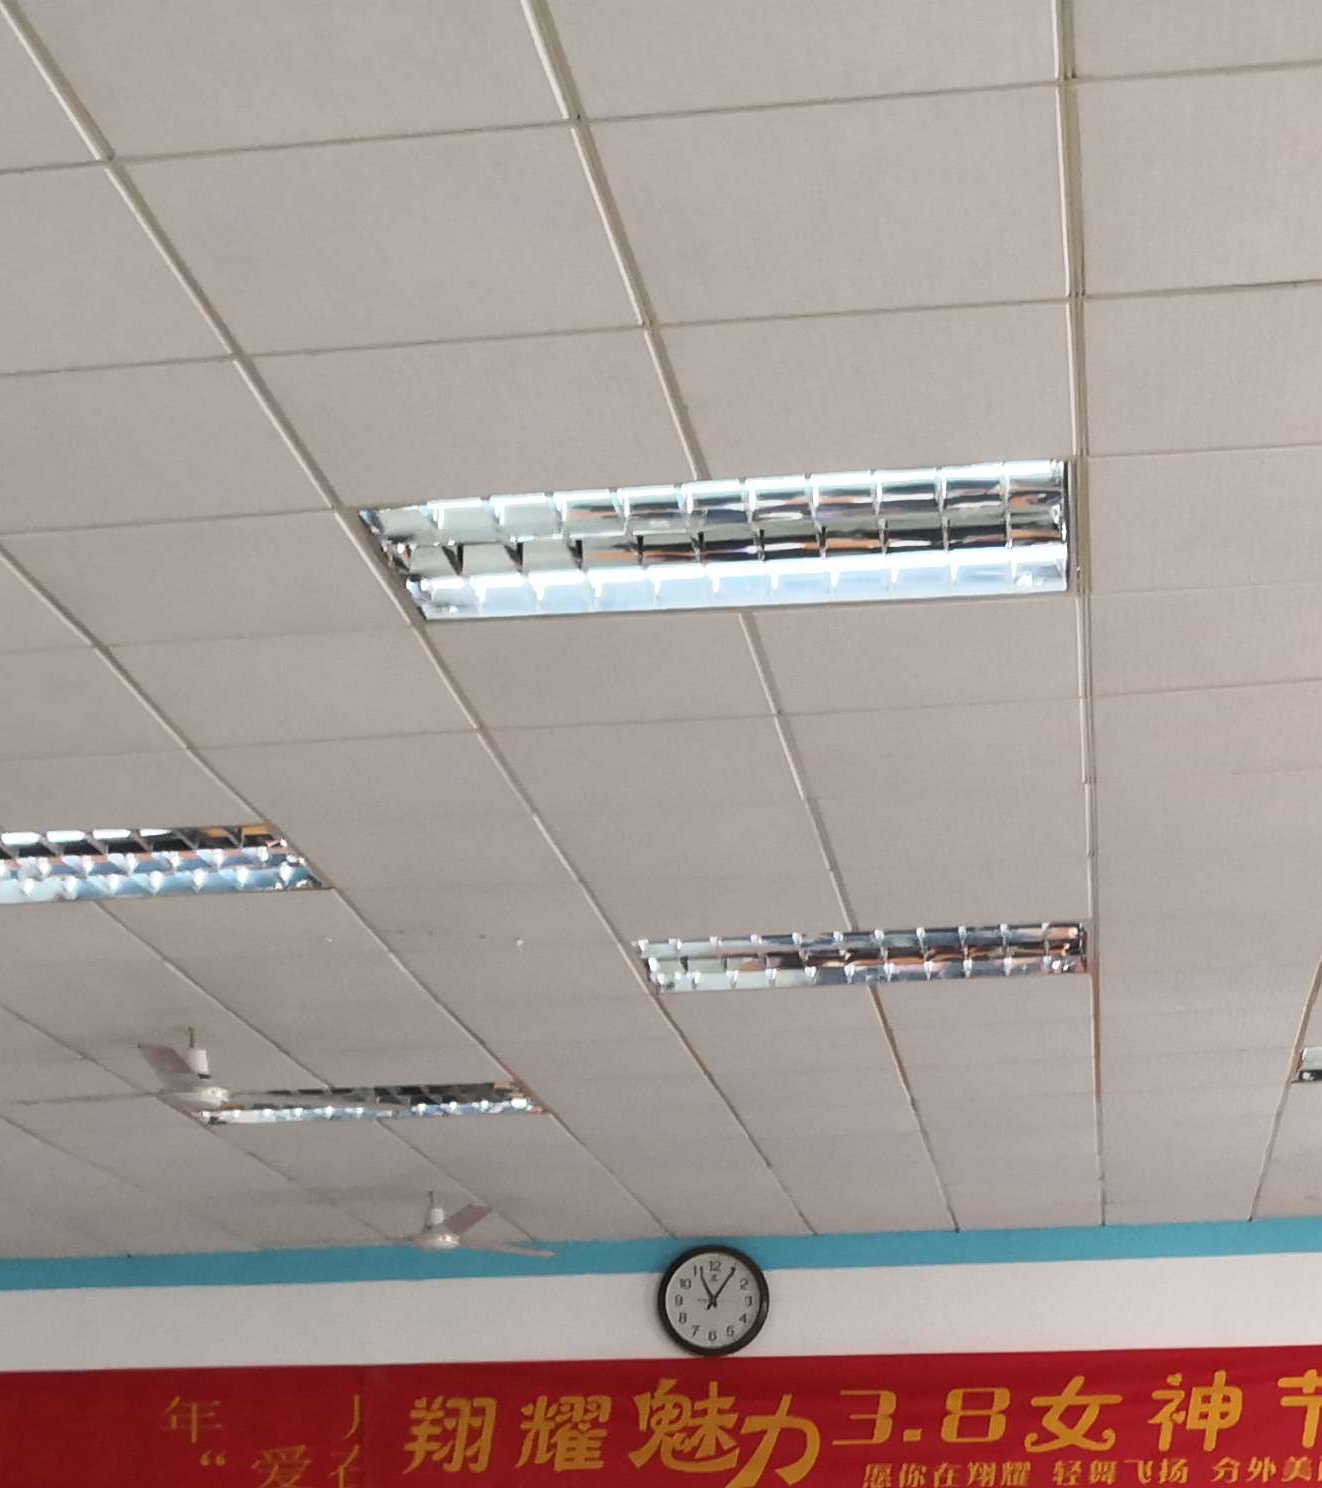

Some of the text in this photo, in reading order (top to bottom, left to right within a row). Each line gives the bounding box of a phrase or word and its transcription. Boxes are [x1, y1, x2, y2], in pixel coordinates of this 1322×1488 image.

[161, 1396, 223, 1444] 年
[862, 1461, 1031, 1488] 愿你在翔耀
[1052, 1456, 1189, 1486] 轻舞飞扬
